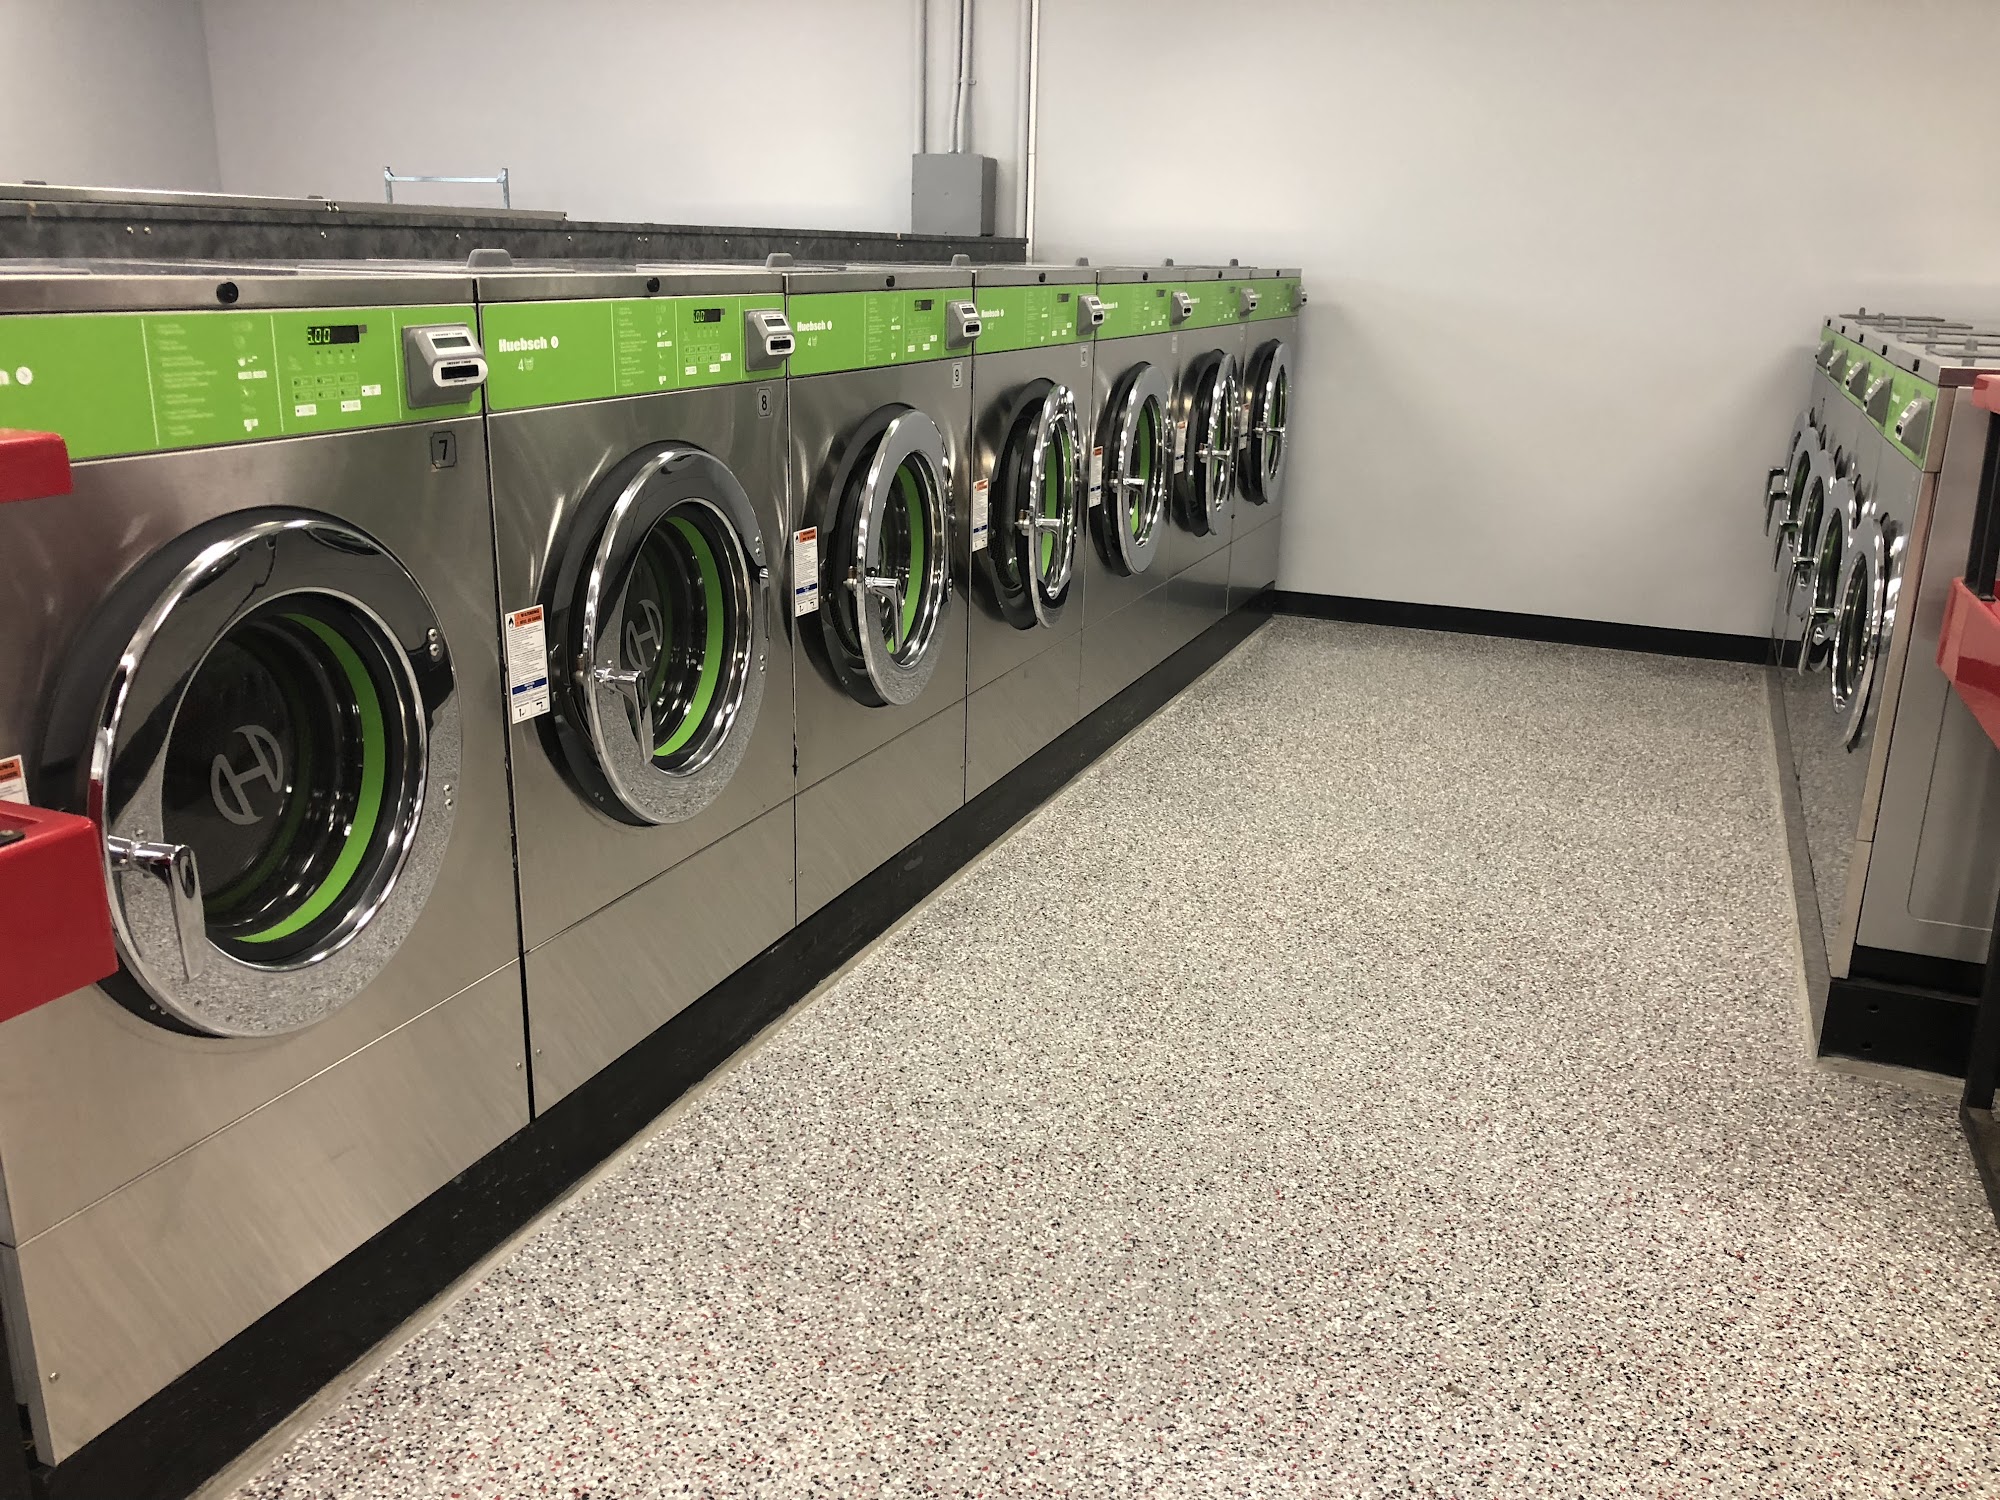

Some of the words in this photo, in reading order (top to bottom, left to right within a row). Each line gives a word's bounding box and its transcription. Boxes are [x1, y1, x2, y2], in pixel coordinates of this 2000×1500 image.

[499, 336, 548, 352] Huebsch
[518, 358, 524, 371] 4
[761, 394, 768, 411] 8
[438, 439, 448, 460] 7
